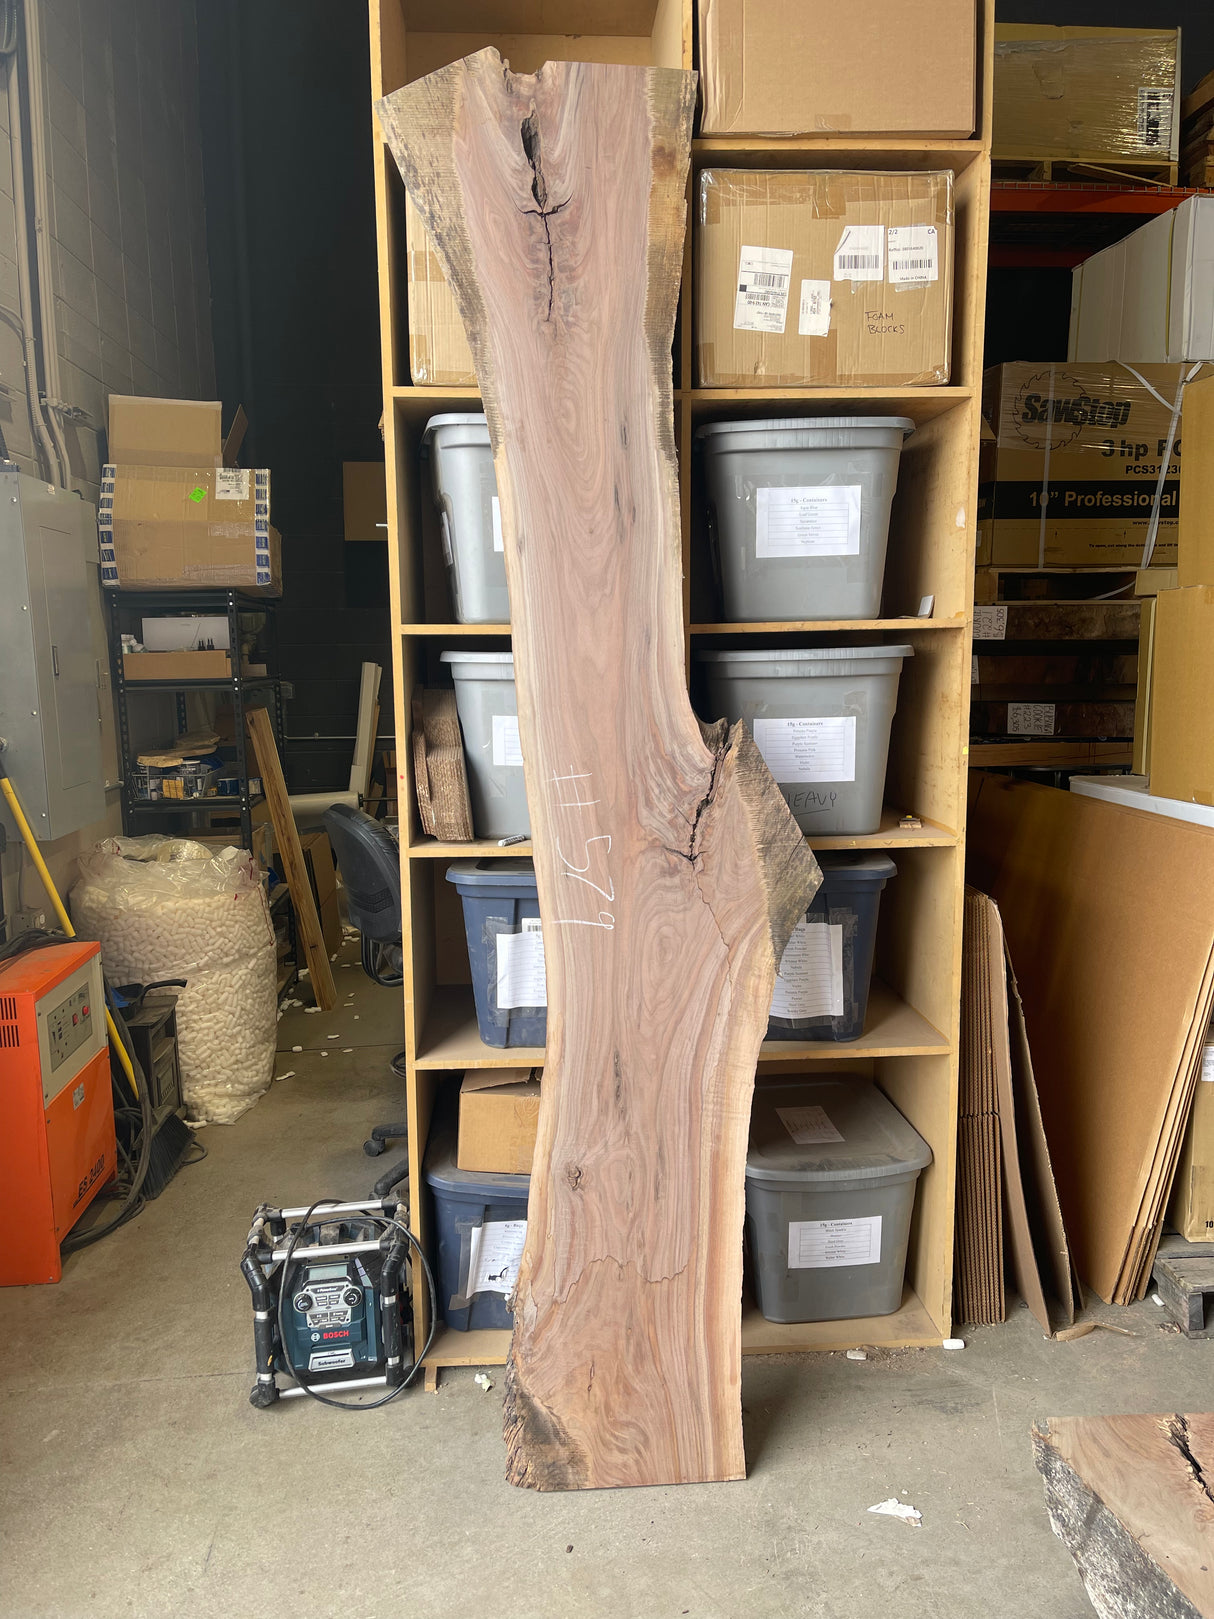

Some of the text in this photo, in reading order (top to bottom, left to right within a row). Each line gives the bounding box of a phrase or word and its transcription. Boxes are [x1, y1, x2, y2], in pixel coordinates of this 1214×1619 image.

[865, 310, 895, 322] FOAM
[867, 324, 905, 335] BLOCKS
[1021, 393, 1132, 428] SawStop
[1101, 439, 1115, 457] 3
[1120, 440, 1149, 461] hp
[1023, 704, 1032, 730] #223
[1033, 704, 1043, 733] COOKIE
[323, 1330, 349, 1339] BOSCH
